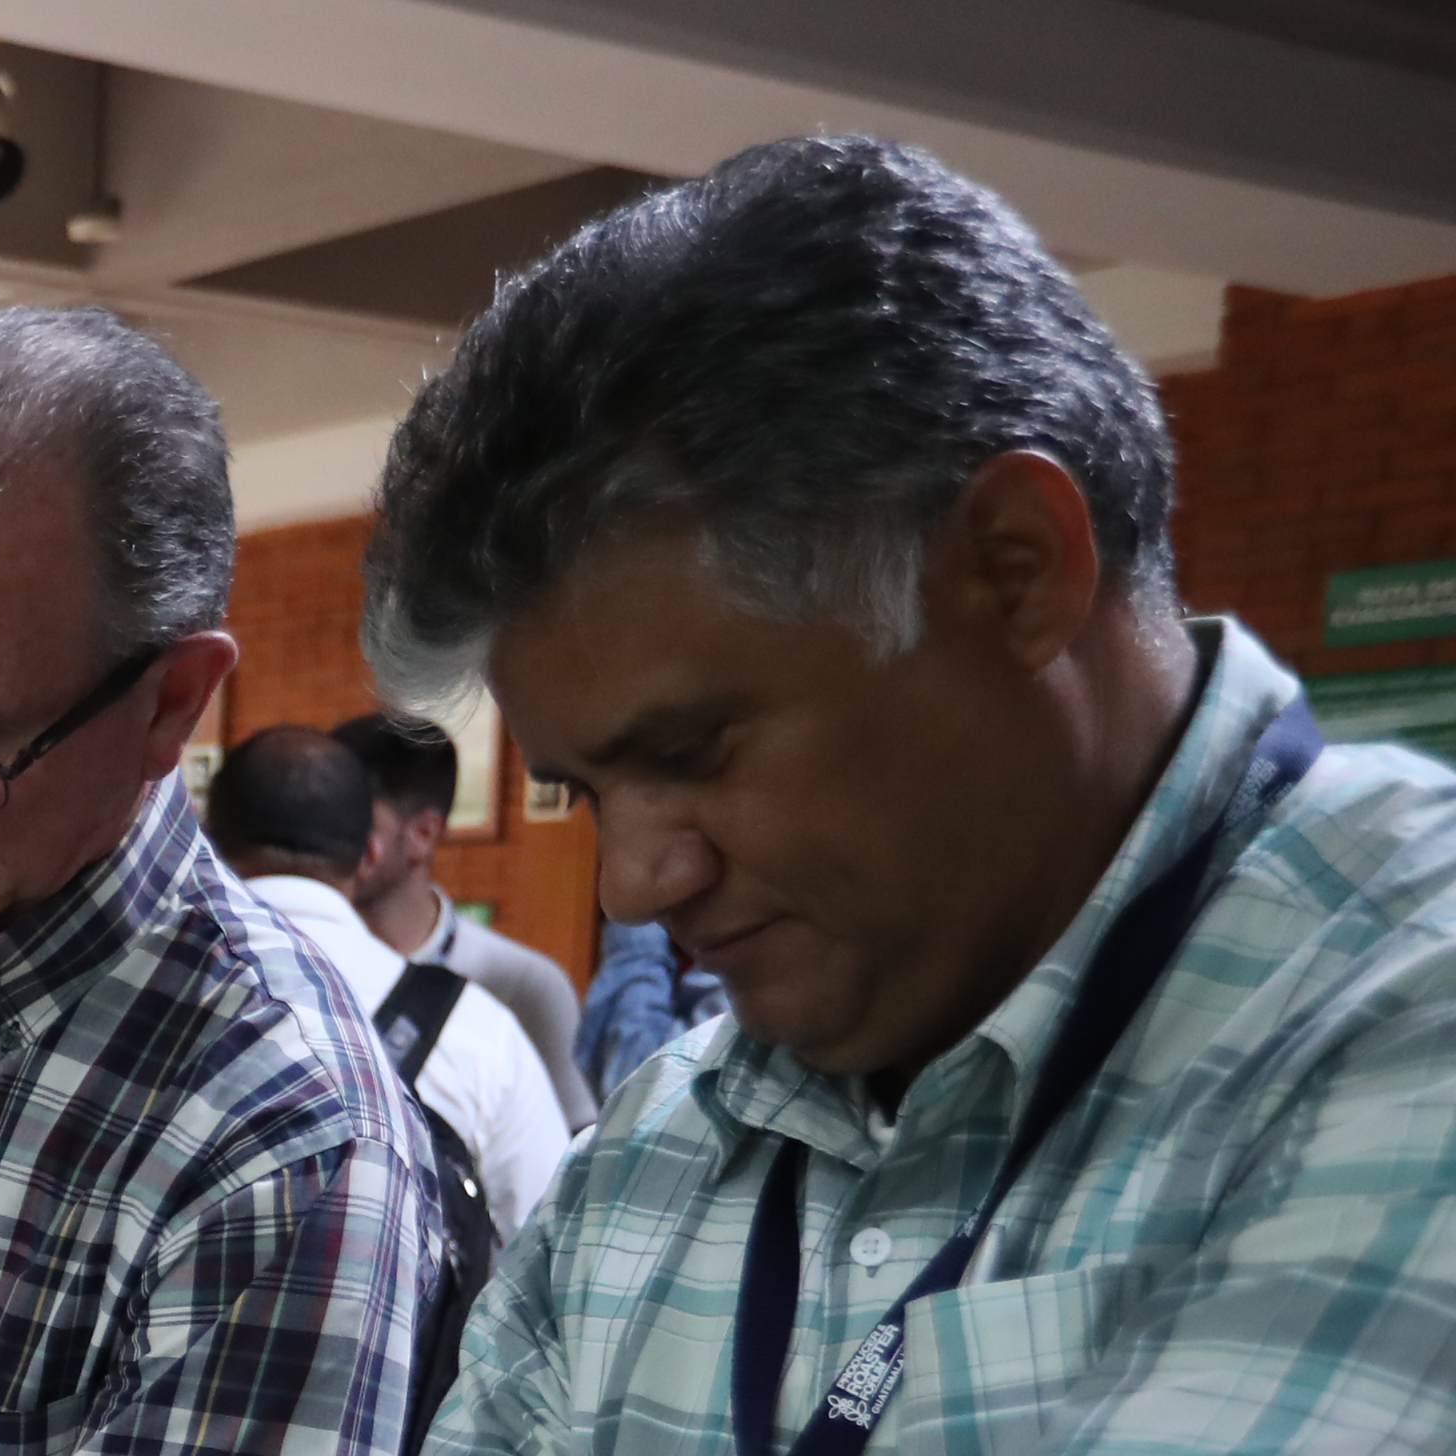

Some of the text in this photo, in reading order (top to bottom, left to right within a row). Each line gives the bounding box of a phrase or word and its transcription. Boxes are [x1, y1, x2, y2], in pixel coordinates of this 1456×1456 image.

[836, 1324, 887, 1389] PRODUCER &
[845, 1324, 900, 1396] ROASTER
[859, 1361, 888, 1402] FORUM
